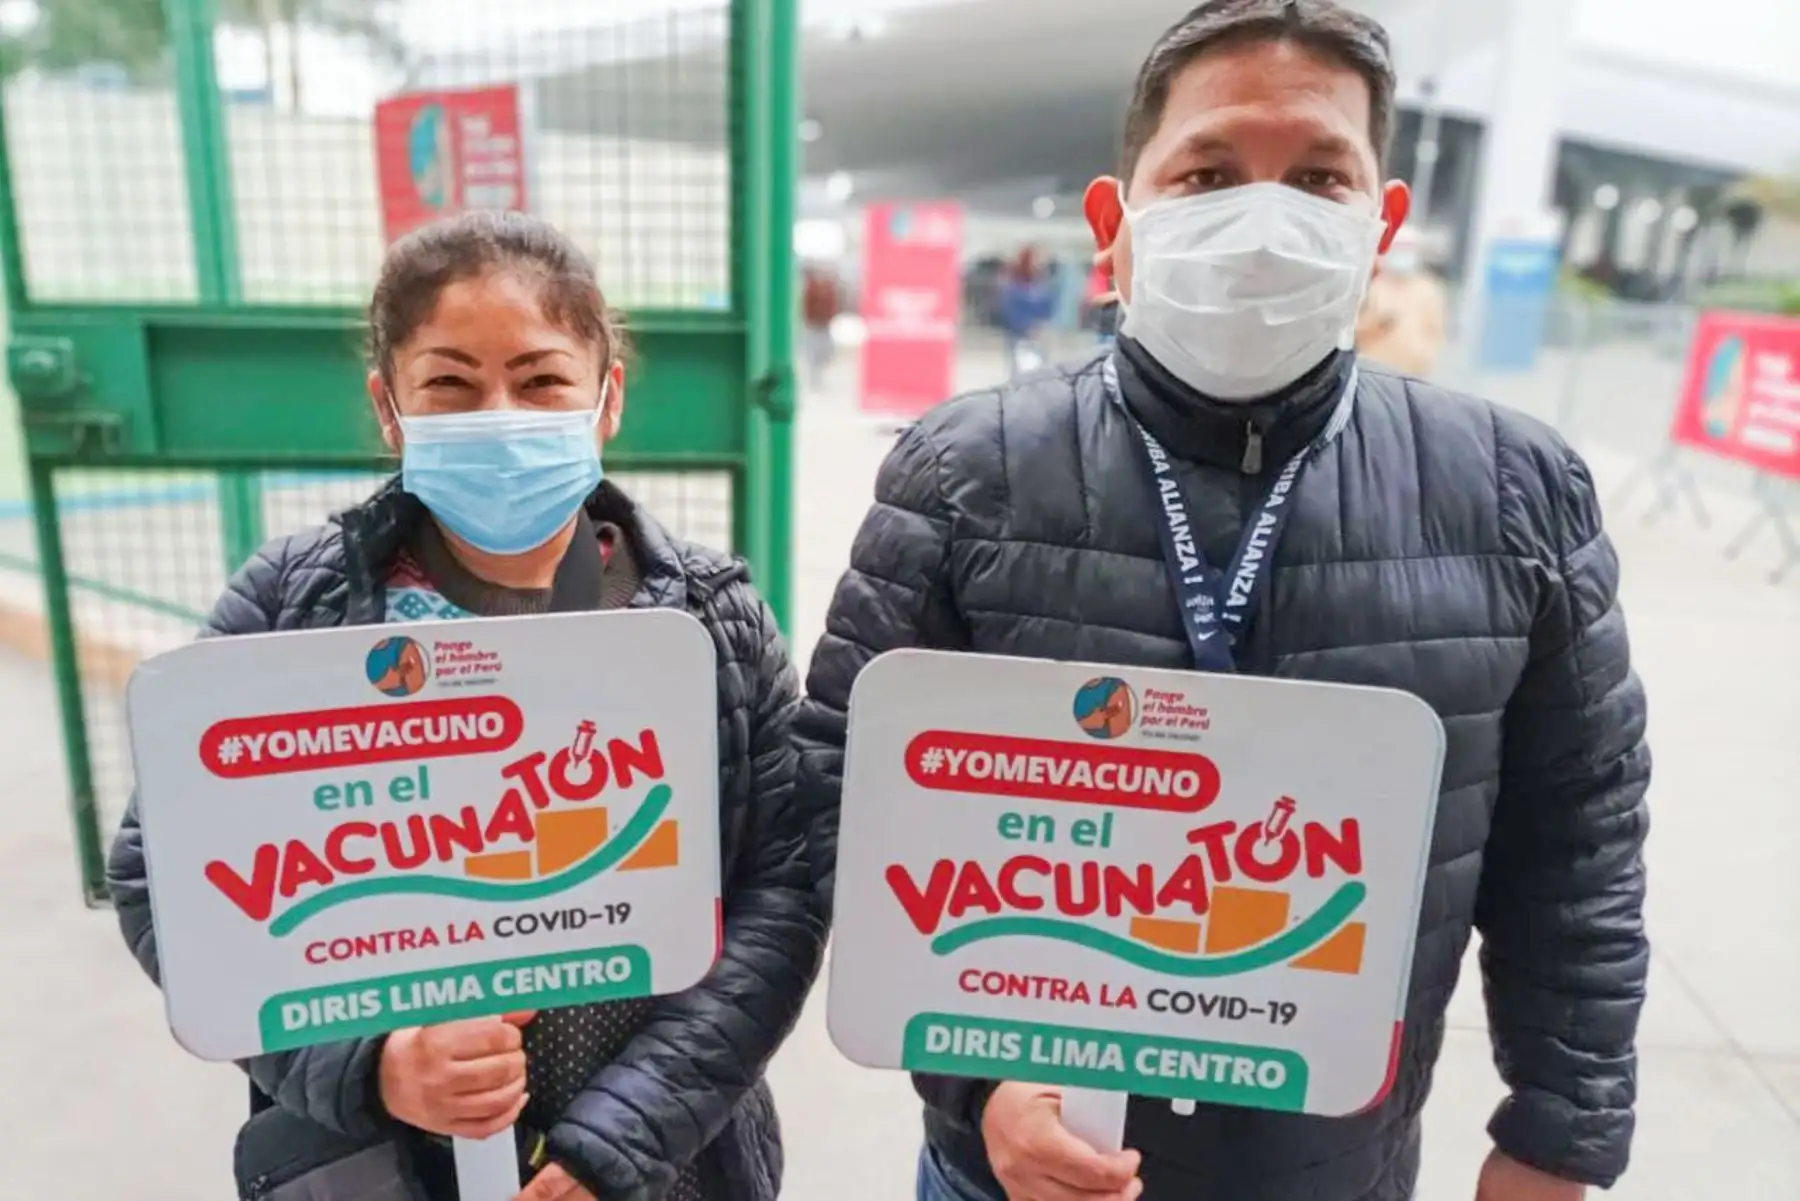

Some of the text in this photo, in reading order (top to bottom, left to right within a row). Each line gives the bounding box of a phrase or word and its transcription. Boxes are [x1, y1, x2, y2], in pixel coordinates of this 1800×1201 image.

[1157, 477, 1200, 573] ALIANZA
[1226, 511, 1277, 608] ALIANZA
[435, 654, 446, 663] el
[435, 666, 457, 679] por
[460, 664, 472, 674] el
[1140, 715, 1162, 727] por
[1166, 716, 1178, 726] el
[1143, 702, 1155, 711] el
[1144, 688, 1185, 703] Pongo
[217, 711, 506, 764] #YOMEVACUNO
[313, 765, 430, 810] en el
[919, 745, 1201, 800] #YOMEVACUNO
[997, 810, 1114, 848] en el
[305, 902, 632, 965] CONTRA LA COVID-19
[281, 956, 632, 1030] DIRIS LIMA CENTRO
[958, 969, 1298, 1026] CONTRA LA COVID-19
[925, 1024, 1286, 1089] DIRIS LIMA CENTRO
